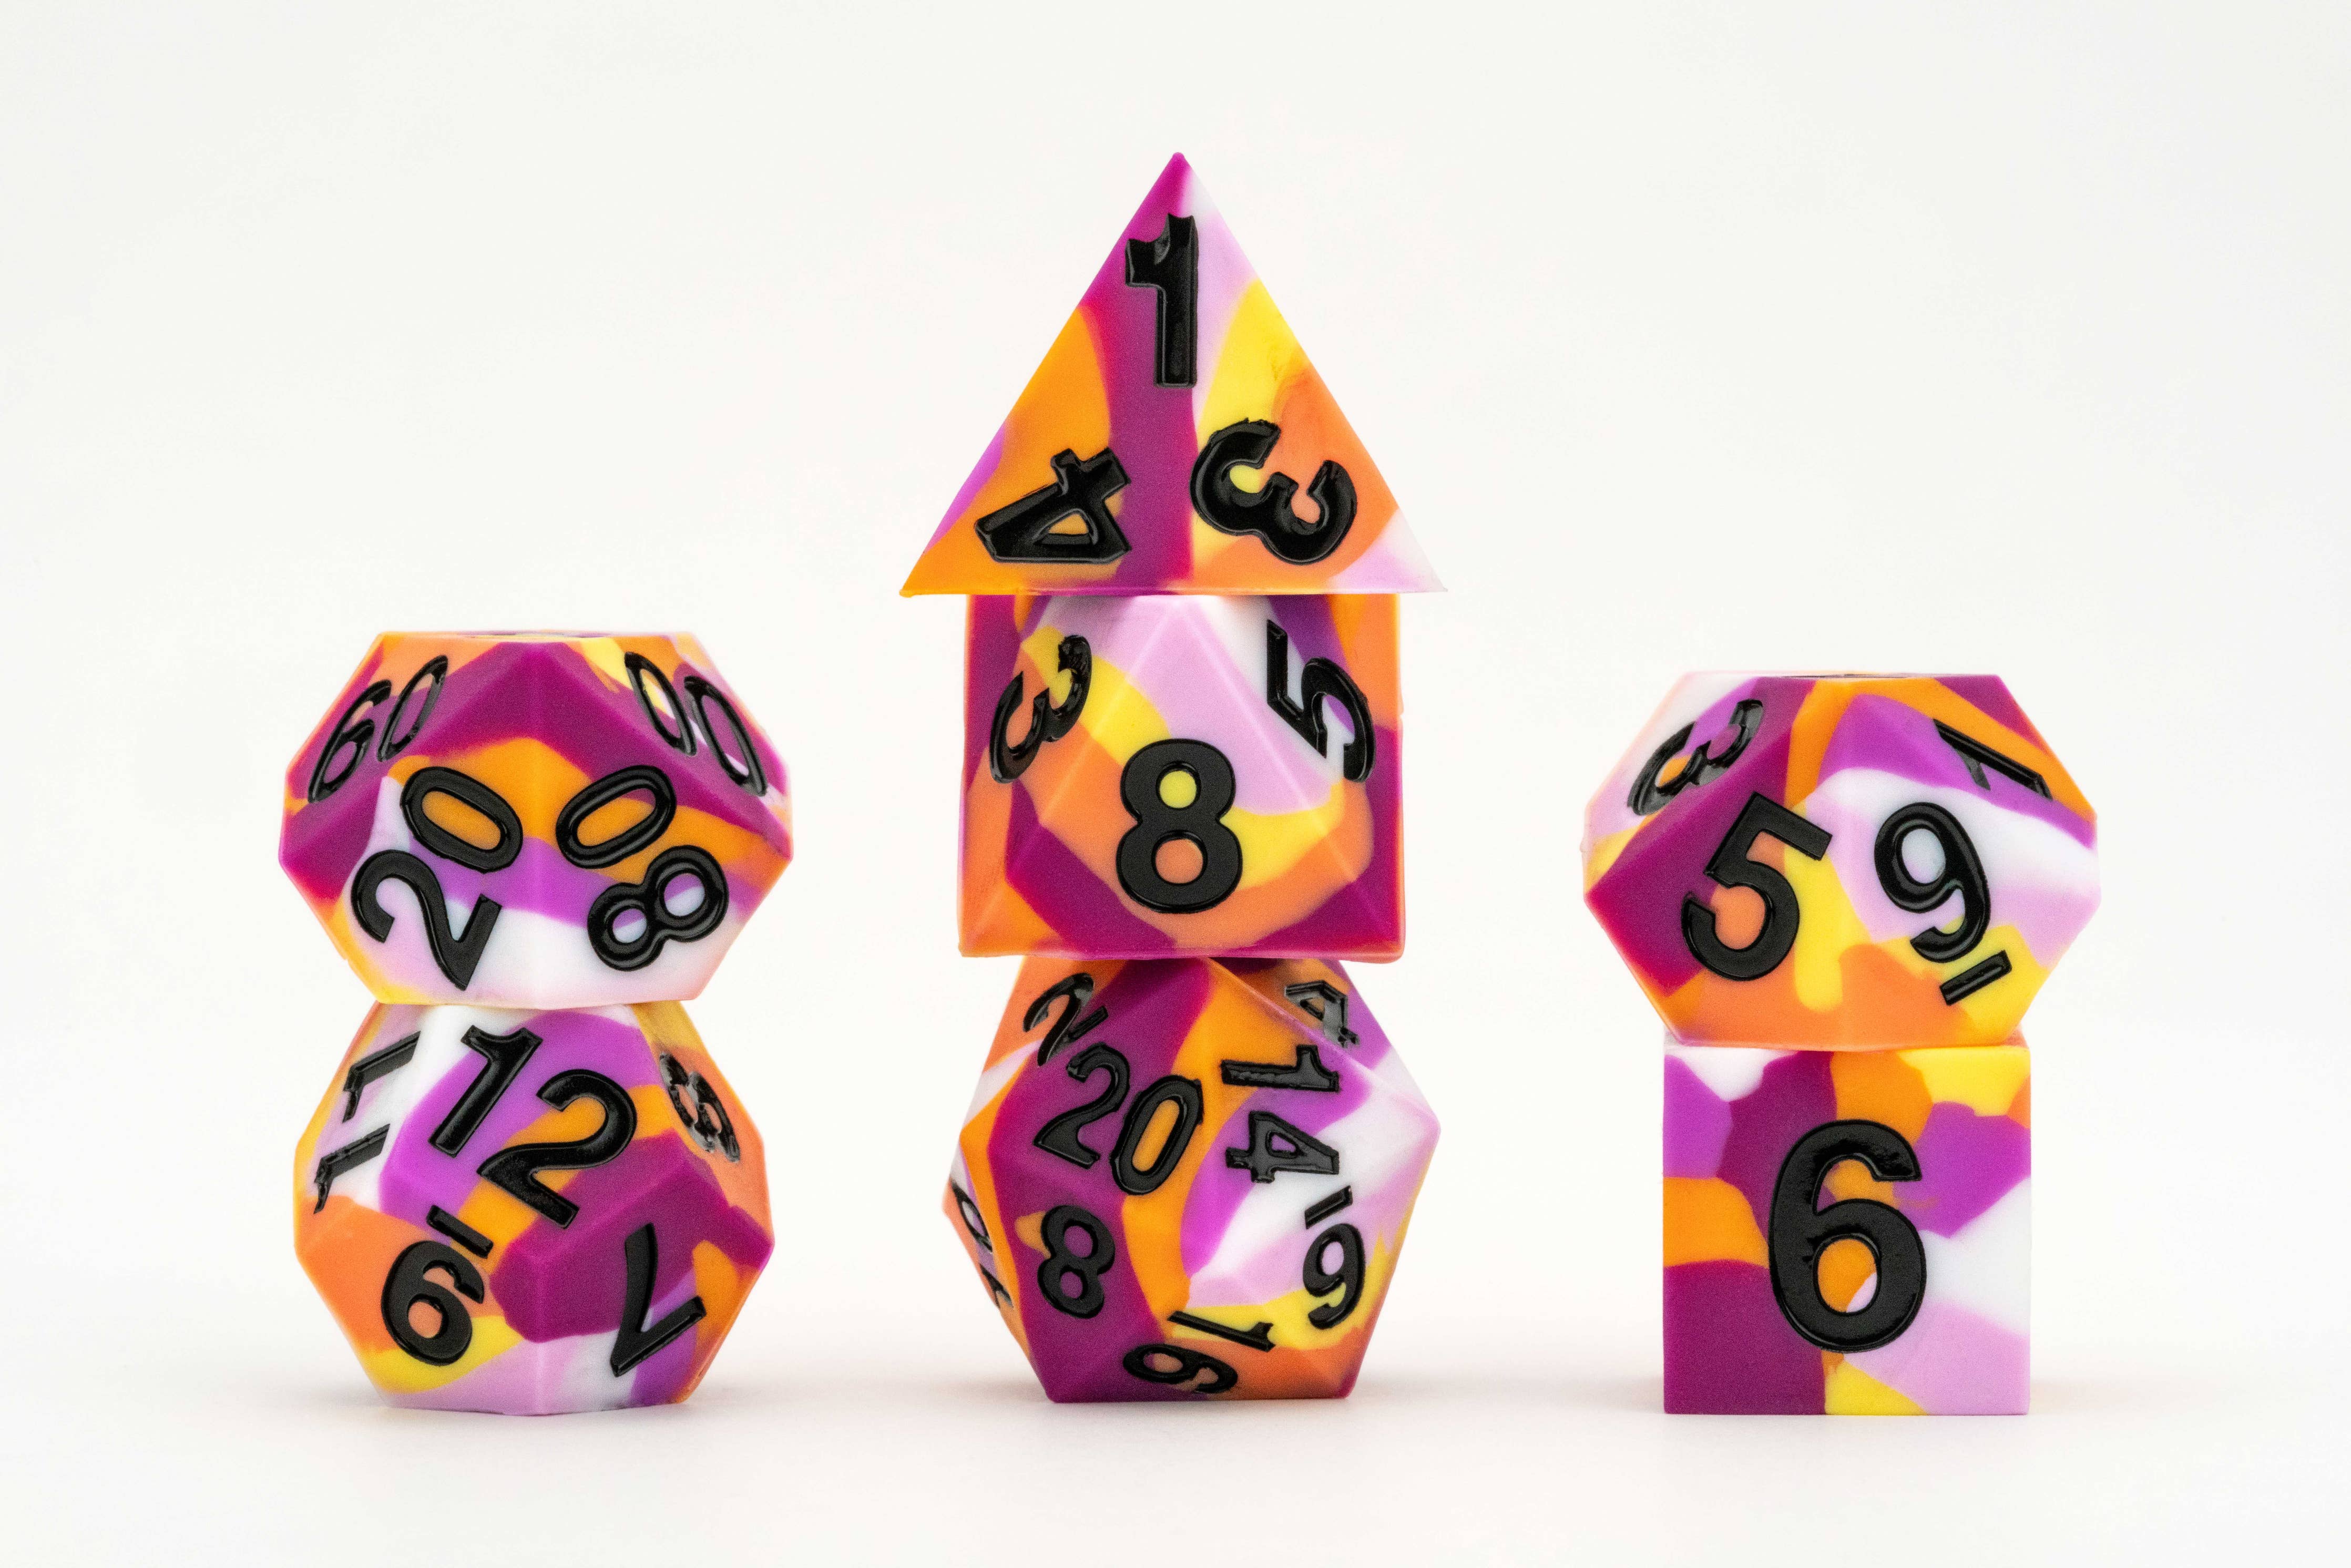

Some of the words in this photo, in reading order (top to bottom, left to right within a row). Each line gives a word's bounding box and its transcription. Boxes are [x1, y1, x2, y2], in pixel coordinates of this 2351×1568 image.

[1125, 213, 1199, 388] 1
[975, 447, 1132, 565] 4
[1189, 418, 1357, 565] 3
[990, 634, 1092, 784] 3
[1267, 619, 1376, 782] 5
[1627, 698, 1764, 815] 3
[1116, 739, 1243, 914] 8
[1680, 791, 1833, 981] 5
[427, 1025, 638, 1229] 12
[1033, 1042, 1204, 1196] 20
[610, 1222, 707, 1377] 7
[1037, 1204, 1116, 1319] 8
[1768, 1119, 1927, 1354] 6
